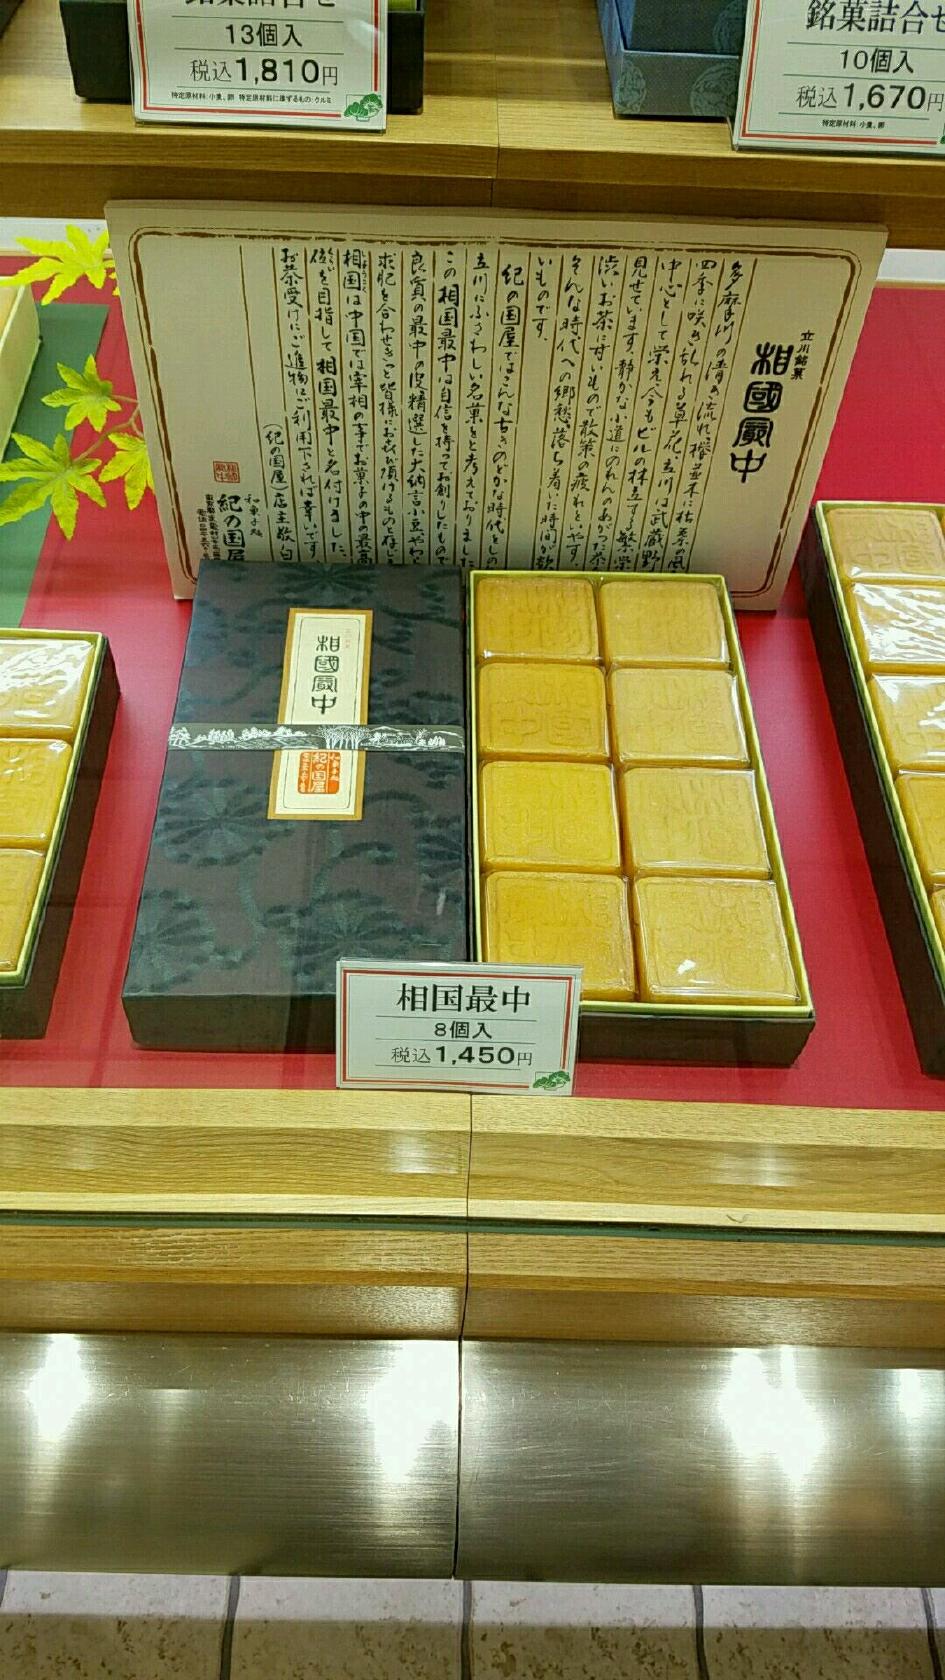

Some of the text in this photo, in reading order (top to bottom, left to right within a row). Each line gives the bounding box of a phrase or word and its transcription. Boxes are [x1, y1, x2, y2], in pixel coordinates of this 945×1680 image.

[225, 22, 303, 47] 13個入
[190, 57, 338, 87] 税込1,810円
[840, 47, 914, 74] 10個入
[796, 83, 944, 112] 税込1,670円
[790, 329, 815, 380] 立川銘菓
[396, 982, 531, 1013] 相国最中
[434, 1020, 493, 1039] 8個入
[391, 1045, 533, 1066] 税込1,450円
